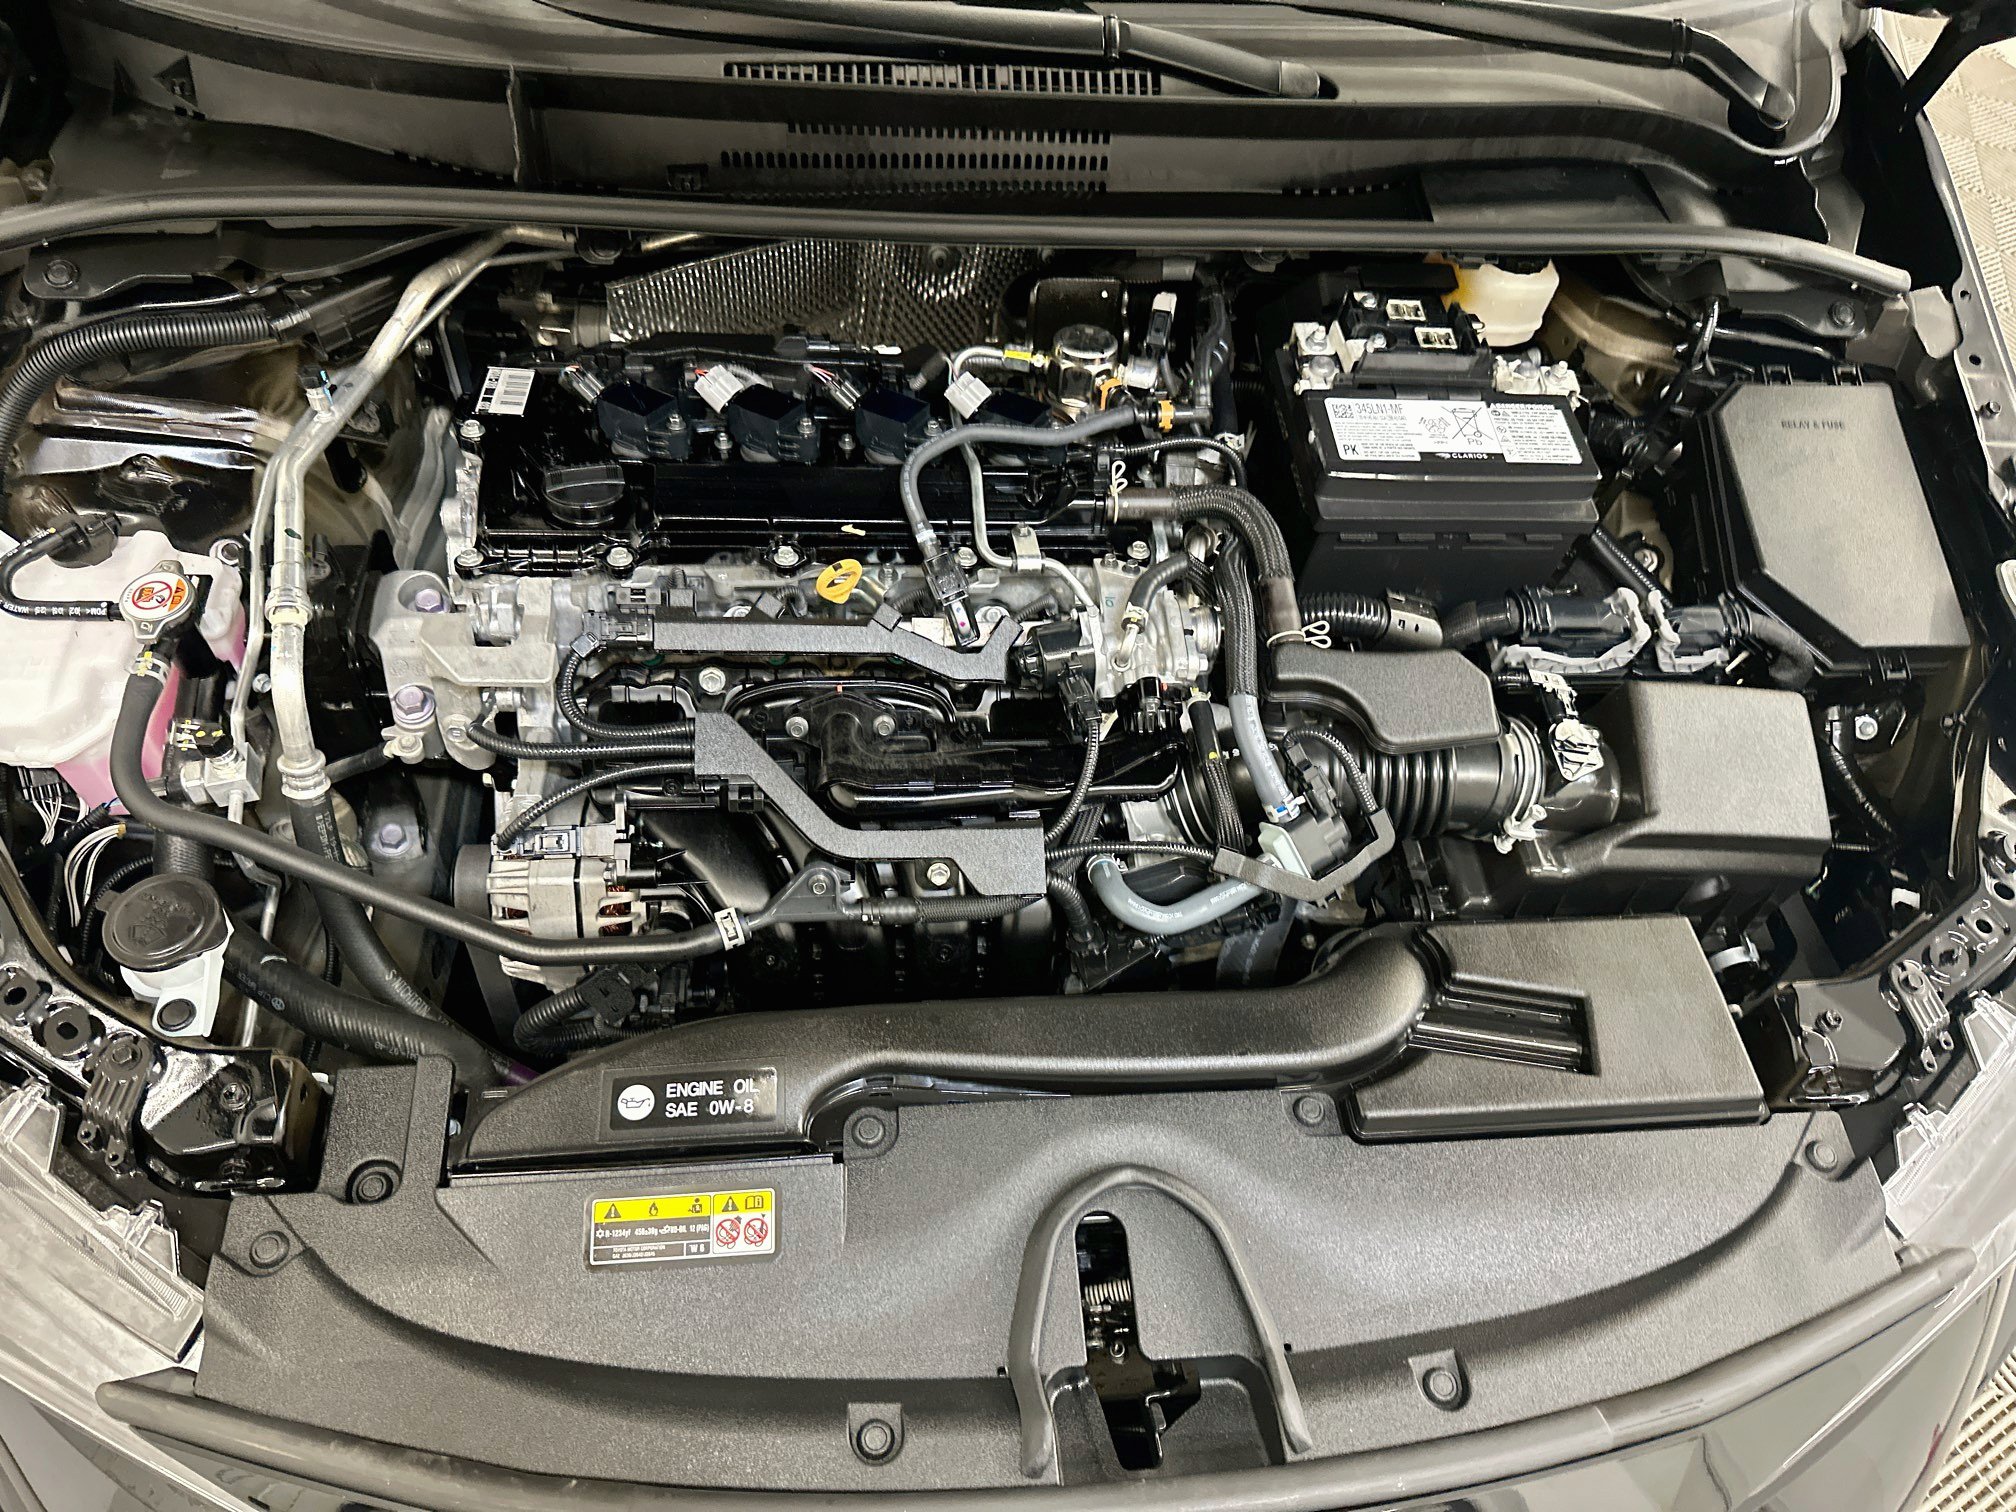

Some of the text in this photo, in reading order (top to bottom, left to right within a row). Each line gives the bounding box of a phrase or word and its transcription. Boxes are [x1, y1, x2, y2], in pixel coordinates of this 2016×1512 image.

[1343, 444, 1359, 456] PK
[391, 975, 431, 1018] NICHIRIN
[665, 1078, 760, 1099] ENGINE OIL
[665, 1099, 754, 1118] SAE 0W-8
[689, 1244, 698, 1253] W
